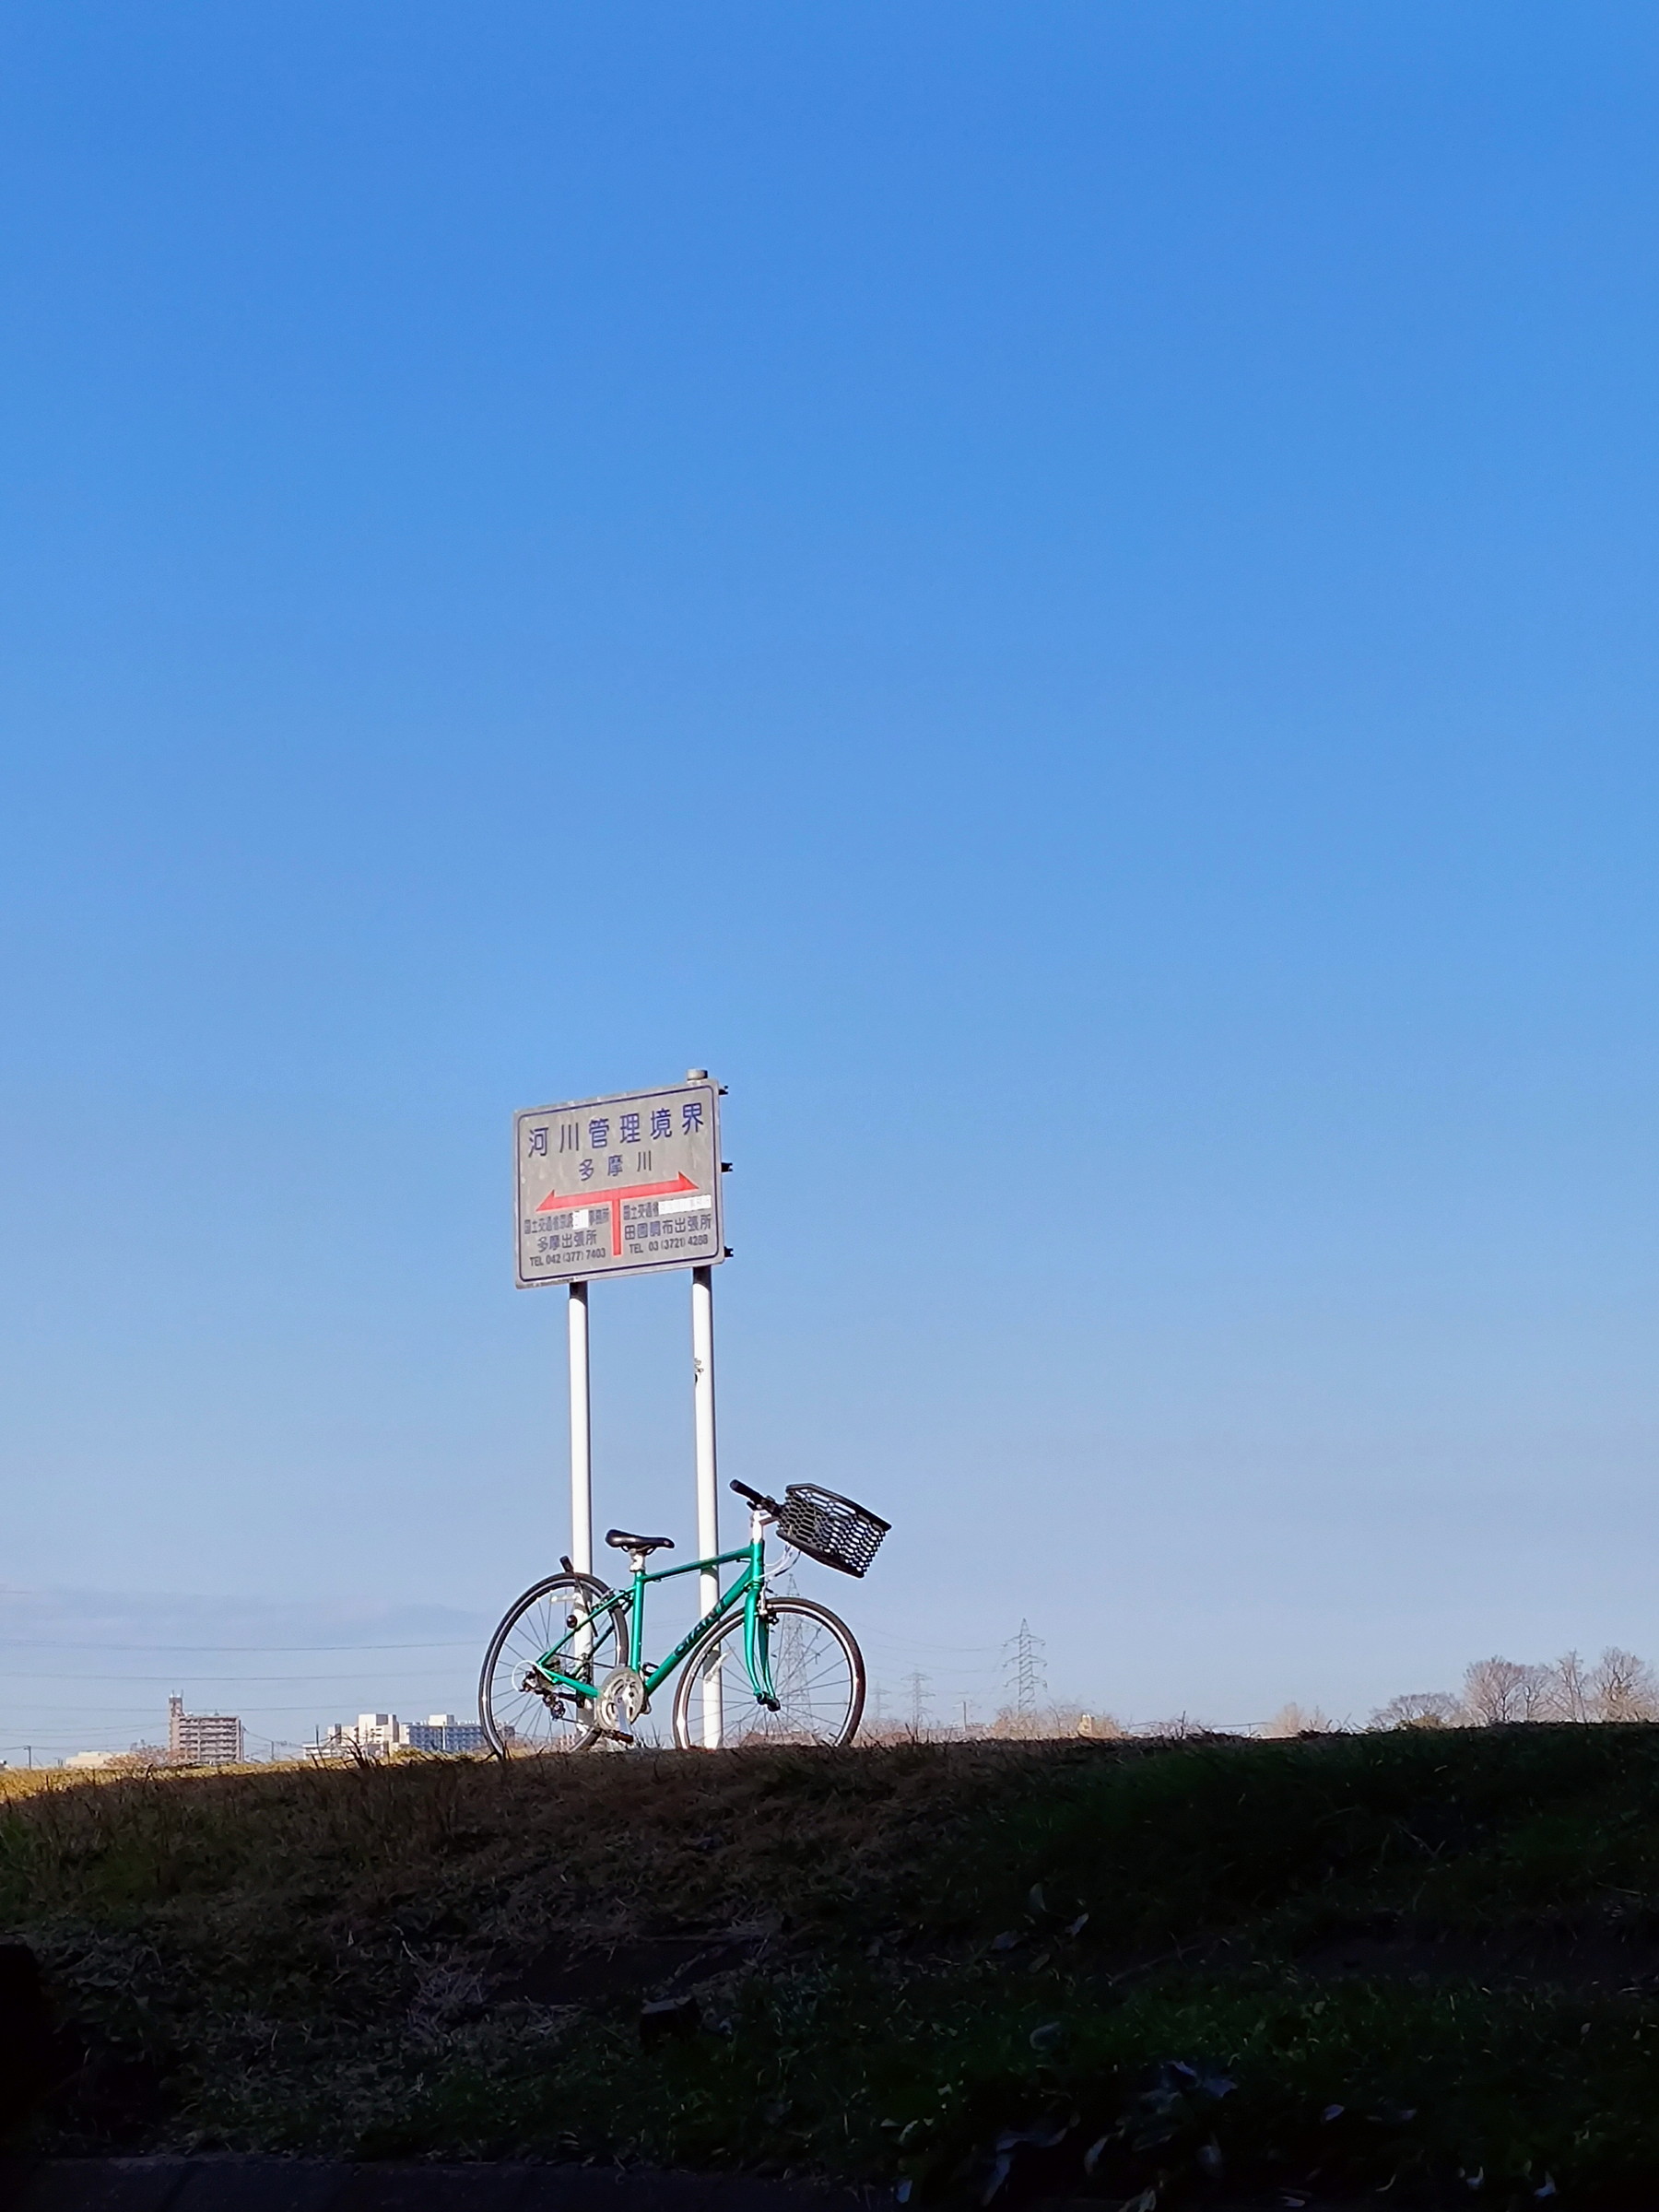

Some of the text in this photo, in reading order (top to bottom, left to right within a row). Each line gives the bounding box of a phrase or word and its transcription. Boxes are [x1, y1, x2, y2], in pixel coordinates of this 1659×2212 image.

[528, 1102, 704, 1159] 河川管理境界
[578, 1150, 653, 1182] 多摩川
[537, 1230, 597, 1253] 多摩出張所
[629, 1243, 643, 1253] TEL
[648, 1241, 659, 1251] 03
[529, 1256, 544, 1266] TEL
[546, 1253, 560, 1265] 042
